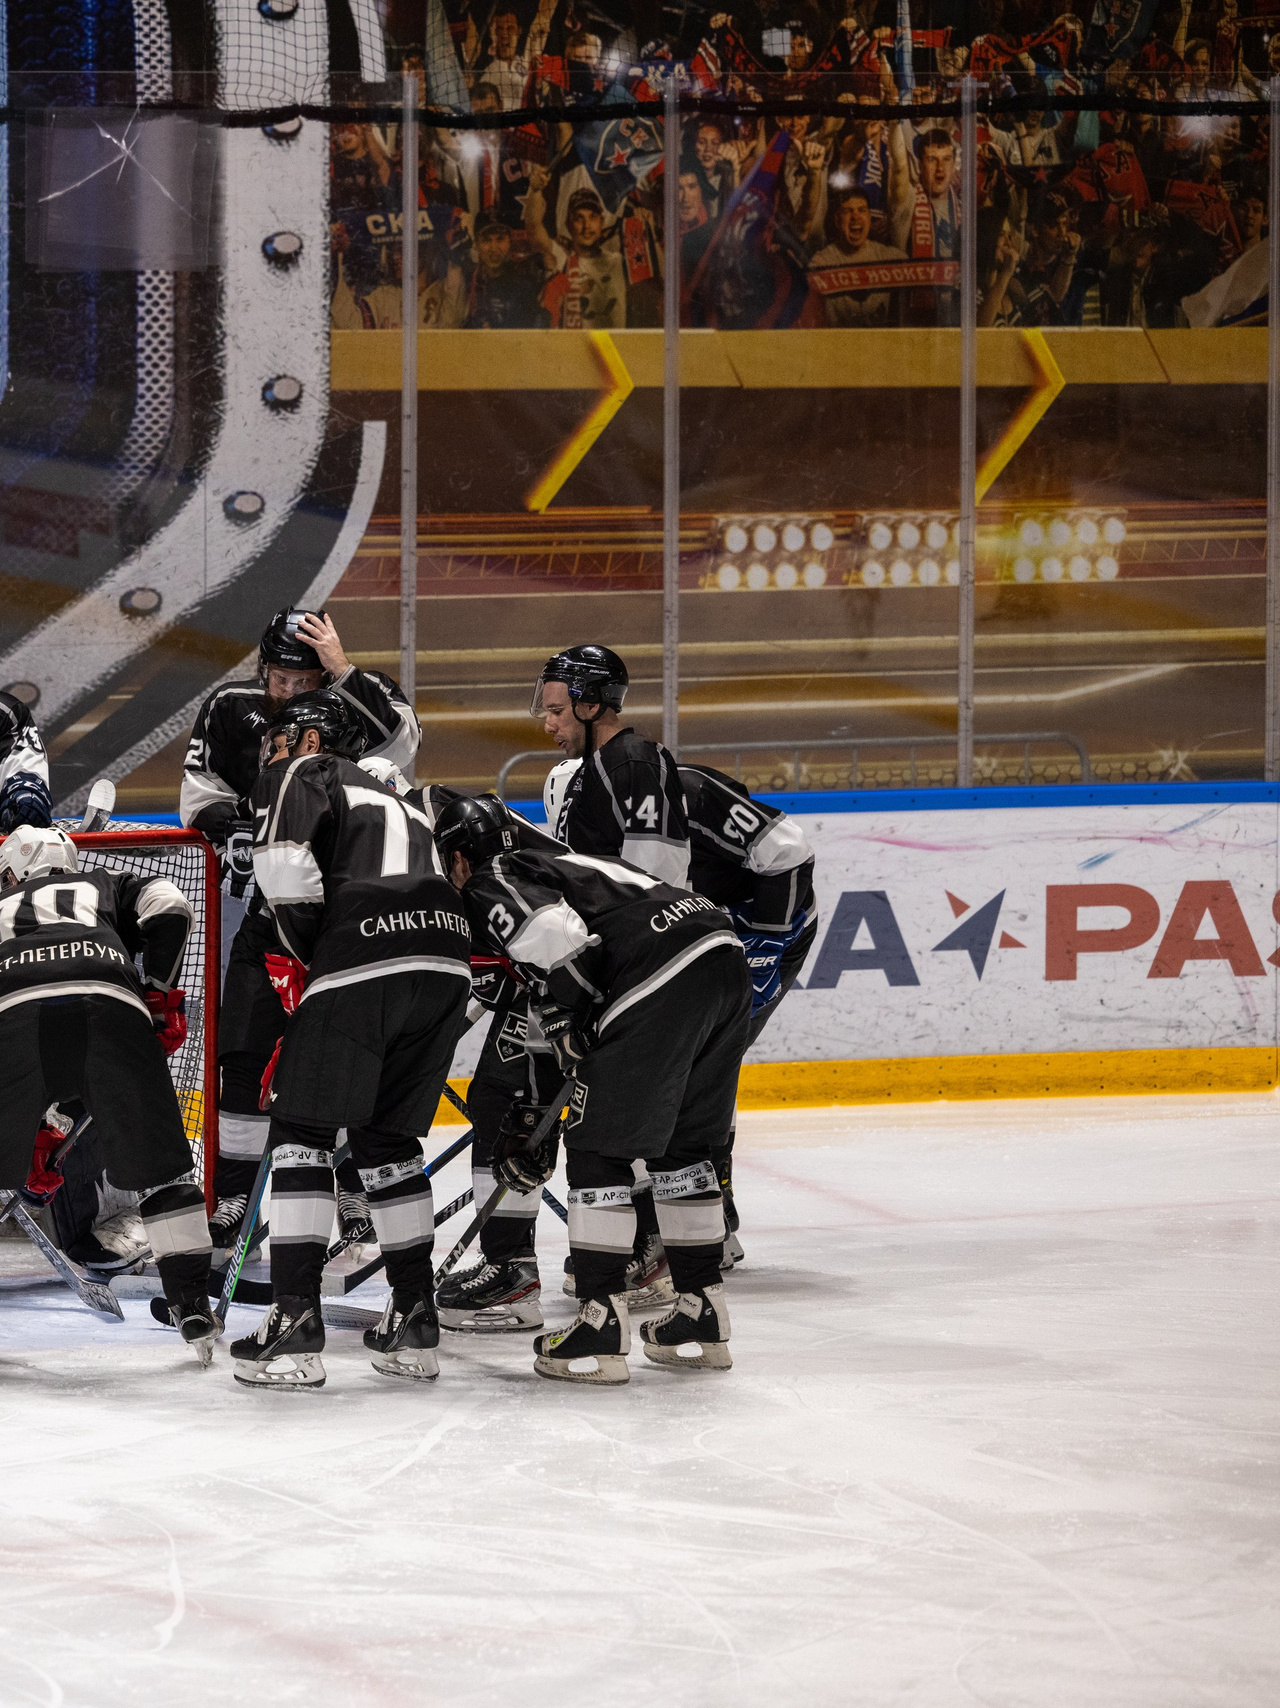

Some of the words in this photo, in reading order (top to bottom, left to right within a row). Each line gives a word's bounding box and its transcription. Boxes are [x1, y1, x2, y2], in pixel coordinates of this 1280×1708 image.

[7, 781, 42, 794] CC
[222, 1234, 246, 1298] BAUER
[433, 1240, 467, 1290] CCM
